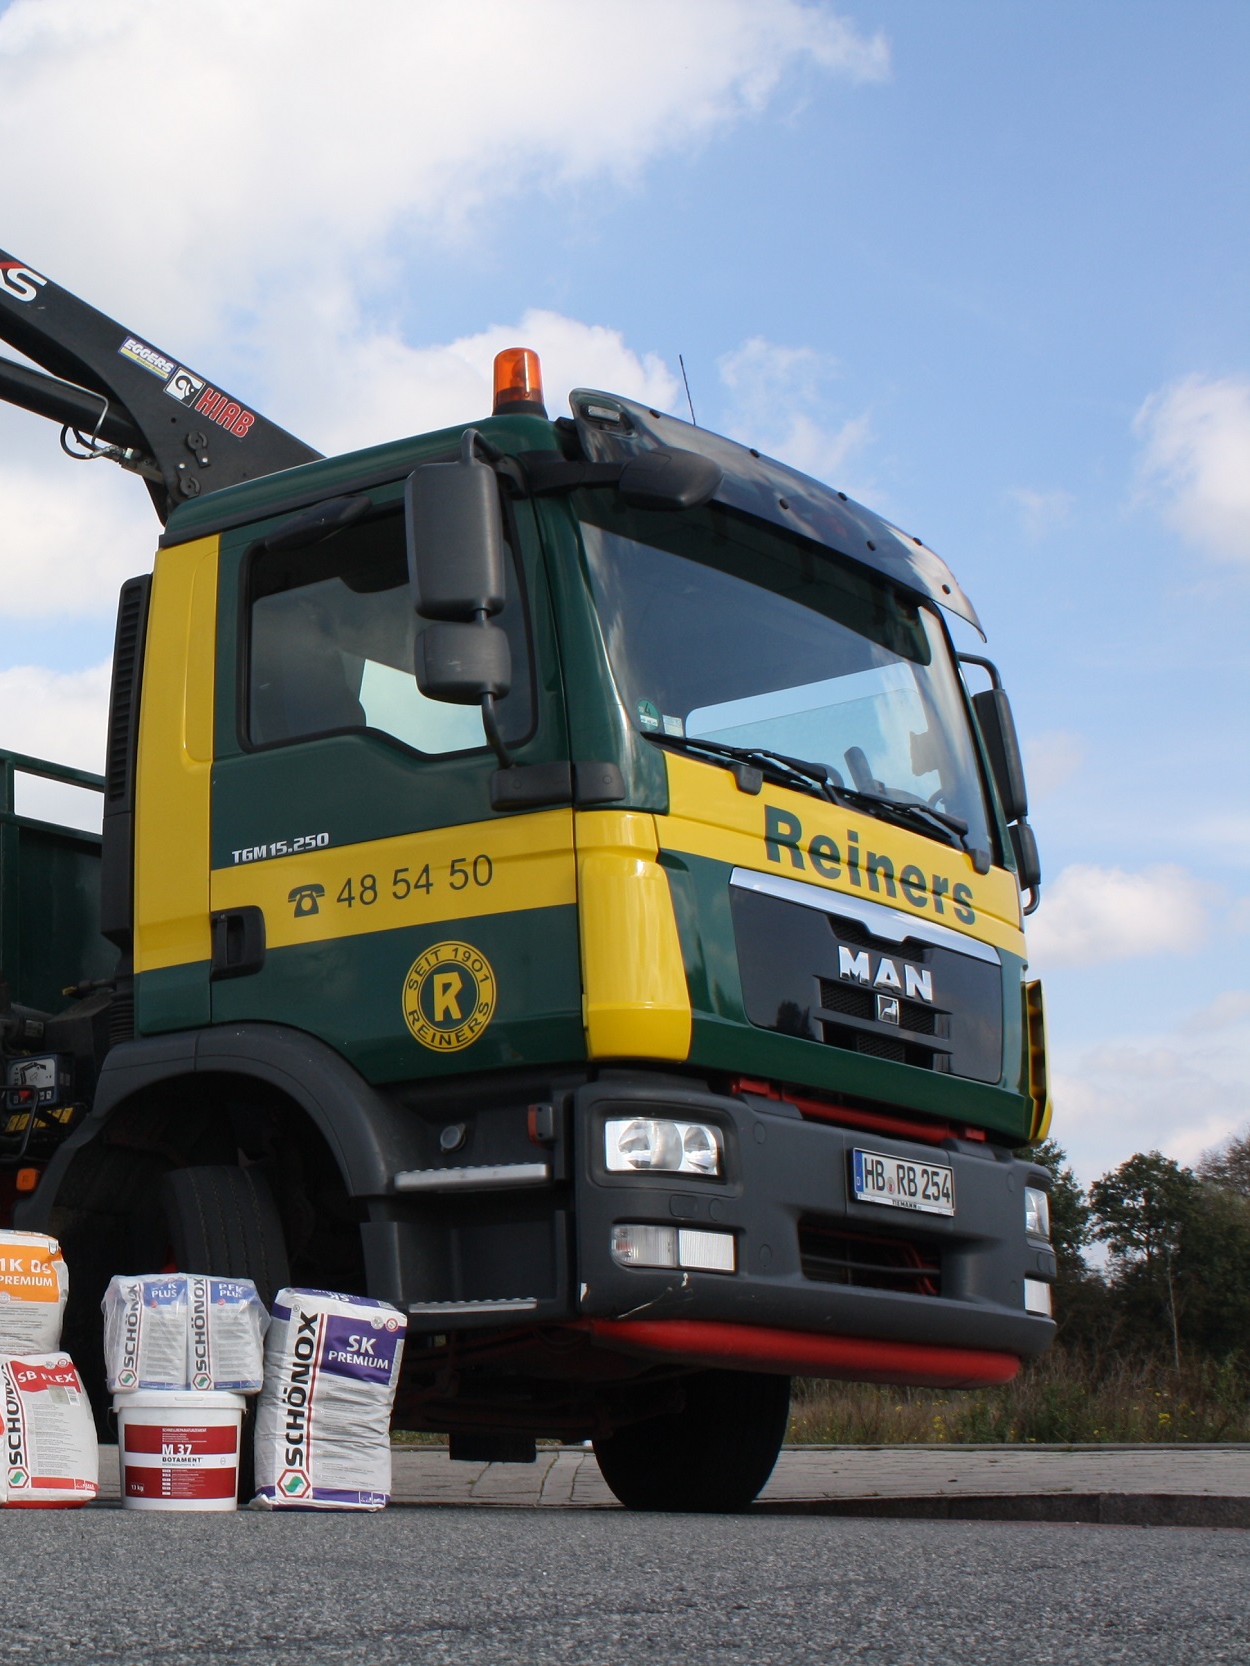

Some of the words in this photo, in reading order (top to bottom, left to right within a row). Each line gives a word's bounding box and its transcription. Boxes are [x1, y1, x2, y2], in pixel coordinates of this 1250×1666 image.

[123, 339, 174, 373] EGGERS
[195, 387, 254, 438] HIAB
[232, 844, 267, 864] TGM
[269, 832, 330, 857] 15.250
[763, 804, 976, 926] Reiners
[336, 873, 379, 908] 48
[391, 863, 434, 900] 54
[449, 854, 493, 891] 50
[407, 949, 442, 992] SEIT
[451, 947, 490, 985] 1901
[838, 945, 934, 1003] MAN
[433, 971, 463, 1022] R
[407, 1001, 491, 1047] REINERS
[864, 1157, 886, 1192] HB
[896, 1163, 918, 1197] RB
[920, 1168, 950, 1203] 254
[151, 1289, 178, 1298] PLUS
[191, 1278, 207, 1372] SCHÖNOX
[346, 1335, 377, 1355] SK
[18, 1370, 37, 1383] SB
[328, 1350, 389, 1370] PREMIUM
[282, 1311, 319, 1467] SCHÖNOX
[162, 1443, 174, 1456] M
[177, 1444, 192, 1456] 37
[162, 1456, 202, 1464] BOTAMENT
[137, 1484, 144, 1492] kg
